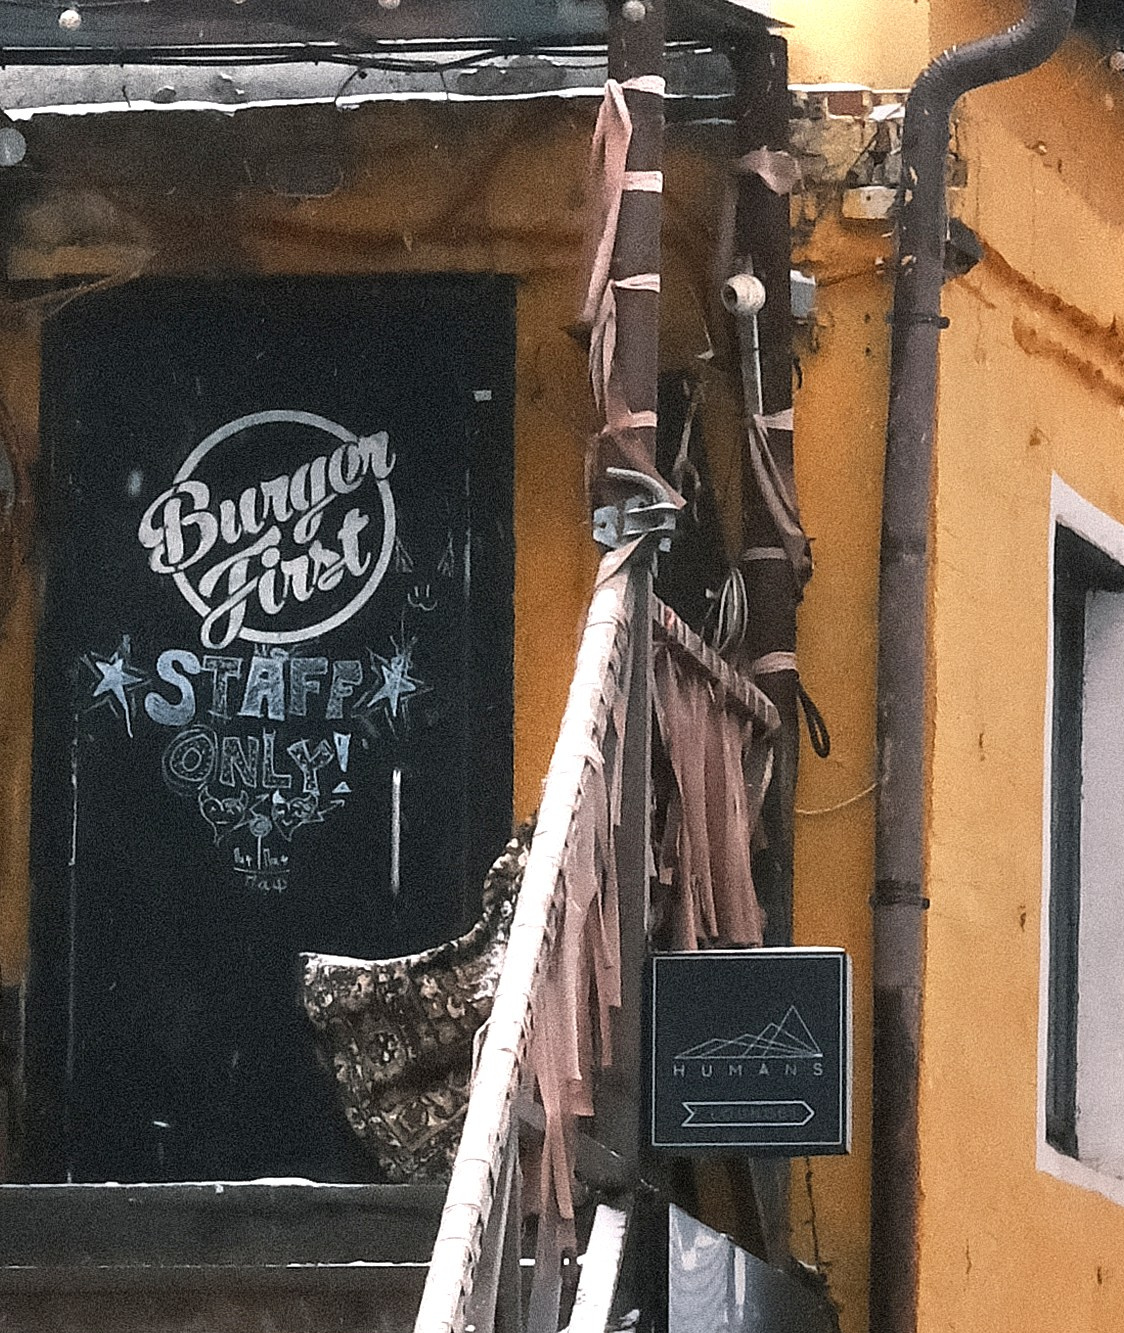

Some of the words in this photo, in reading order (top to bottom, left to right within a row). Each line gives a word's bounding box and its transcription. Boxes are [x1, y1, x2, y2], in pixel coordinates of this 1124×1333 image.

[139, 431, 396, 573] Burger
[199, 514, 371, 649] First
[145, 649, 363, 725] STAFF
[164, 726, 352, 795] ONLY!
[673, 1063, 823, 1077] HUMANS
